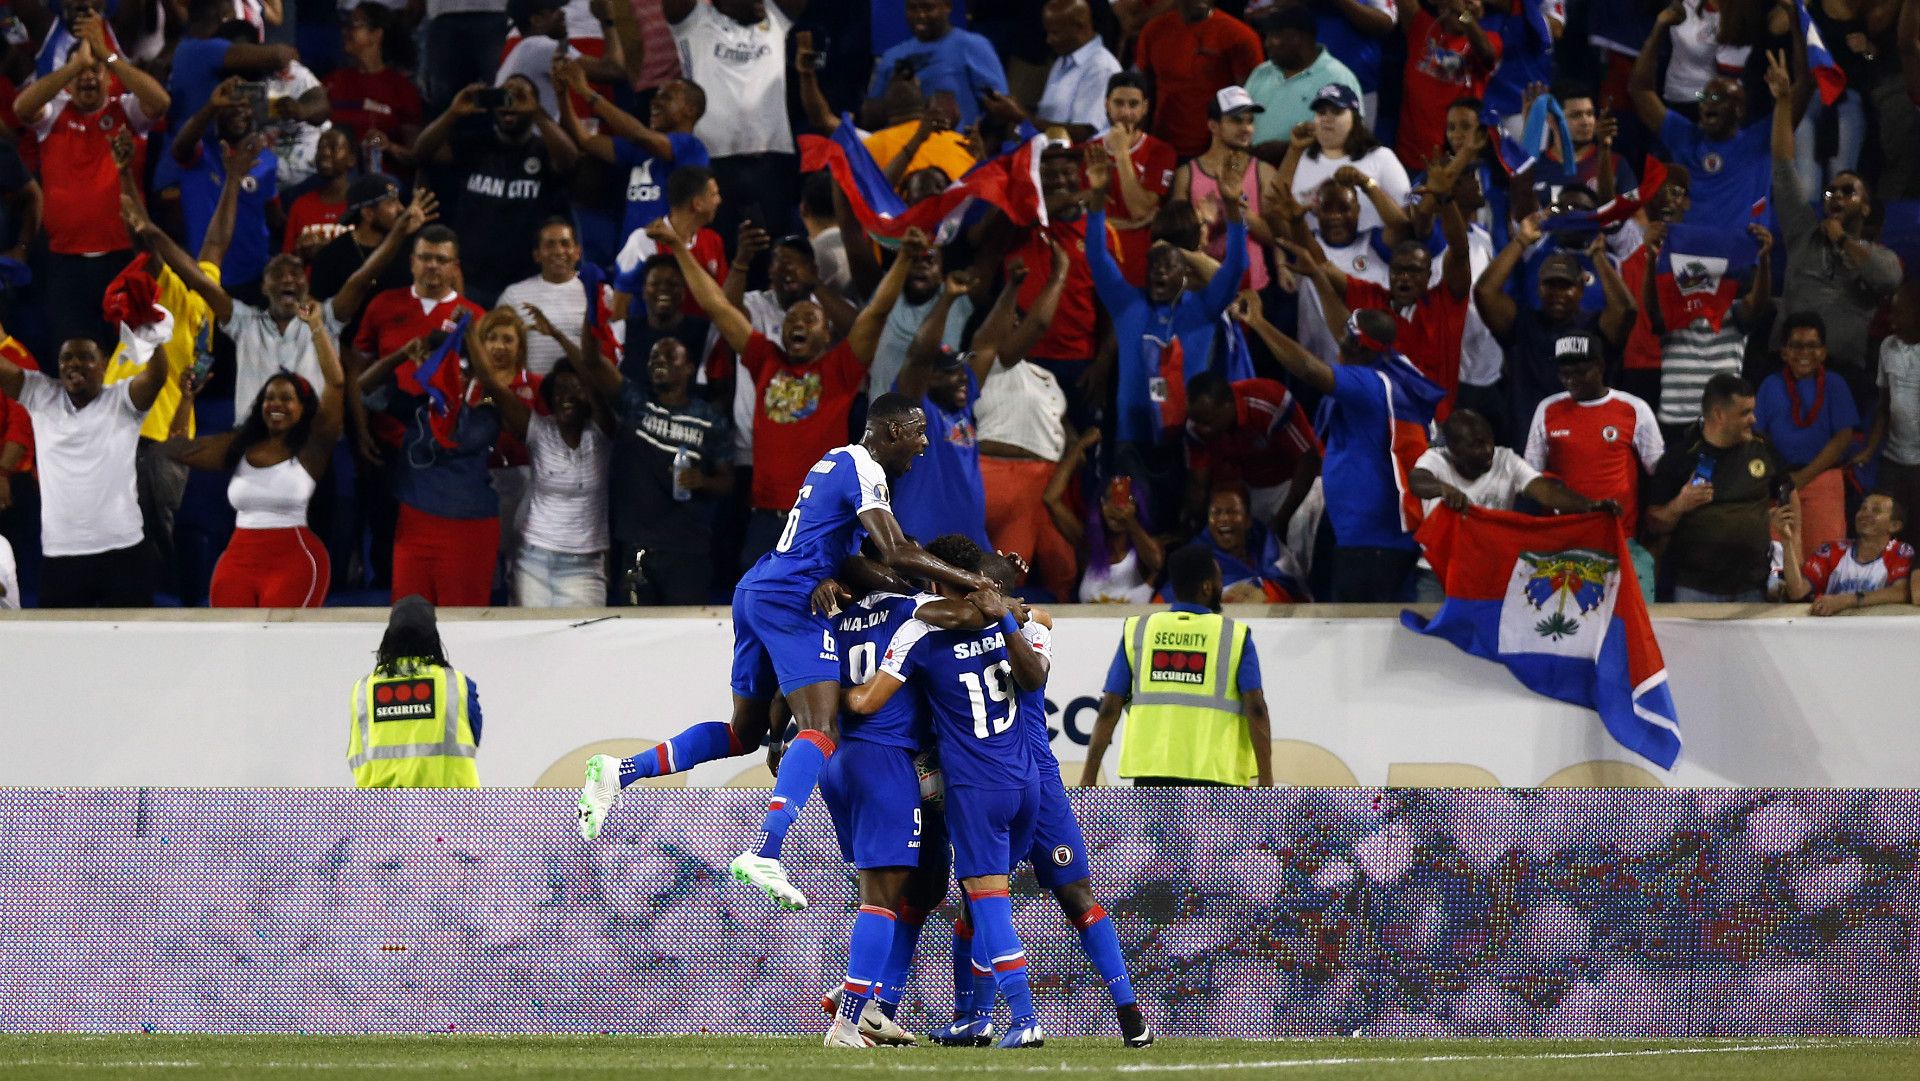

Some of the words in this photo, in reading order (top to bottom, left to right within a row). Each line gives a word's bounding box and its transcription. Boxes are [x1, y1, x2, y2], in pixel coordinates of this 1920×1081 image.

[467, 173, 505, 198] MAN
[508, 178, 541, 199] CITY
[776, 485, 814, 553] 6
[953, 631, 1007, 660] SABA
[1154, 632, 1208, 647] SECURITY
[1151, 670, 1203, 683] SECURITAS
[376, 703, 432, 717] SECURITAS
[958, 659, 1018, 740] 19
[913, 807, 922, 836] 9
